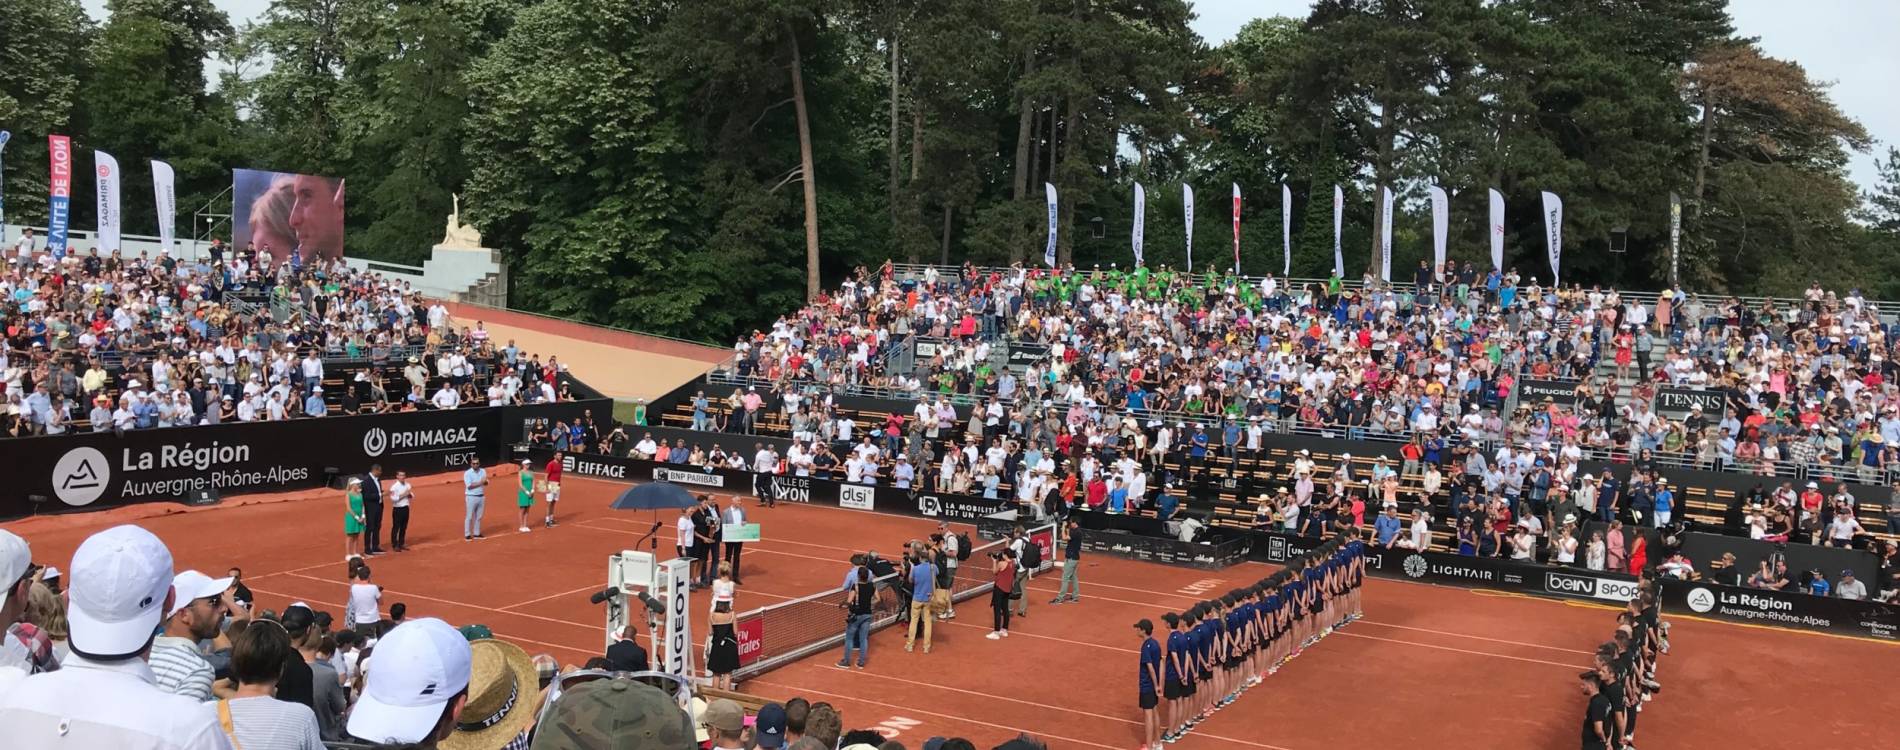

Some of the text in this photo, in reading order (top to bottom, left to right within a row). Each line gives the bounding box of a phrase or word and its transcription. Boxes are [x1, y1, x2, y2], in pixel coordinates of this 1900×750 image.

[1533, 387, 1574, 396] PEUGEO
[1660, 392, 1721, 410] TENNIS
[391, 427, 478, 449] PRIMAGAZ
[122, 440, 250, 472] La Région
[444, 452, 476, 467] NEXT
[578, 461, 626, 478] EIFFAGE
[121, 465, 308, 498] Auvergne-Rhône-Alpes
[670, 471, 718, 485] BNP PARIBAS
[774, 476, 810, 488] VILLE DE
[842, 487, 867, 502] dlsi
[945, 509, 958, 517] EST
[1271, 550, 1282, 558] NIS
[1432, 564, 1493, 580] LIGHTAIR
[1176, 579, 1229, 595] LYON
[1601, 583, 1640, 598] SPOR
[1720, 591, 1793, 611] La Région
[1720, 606, 1831, 627] Auvergne-Rhône-Alpes
[674, 576, 685, 675] UGEOT
[737, 638, 761, 656] irates
[864, 715, 923, 739] ON
